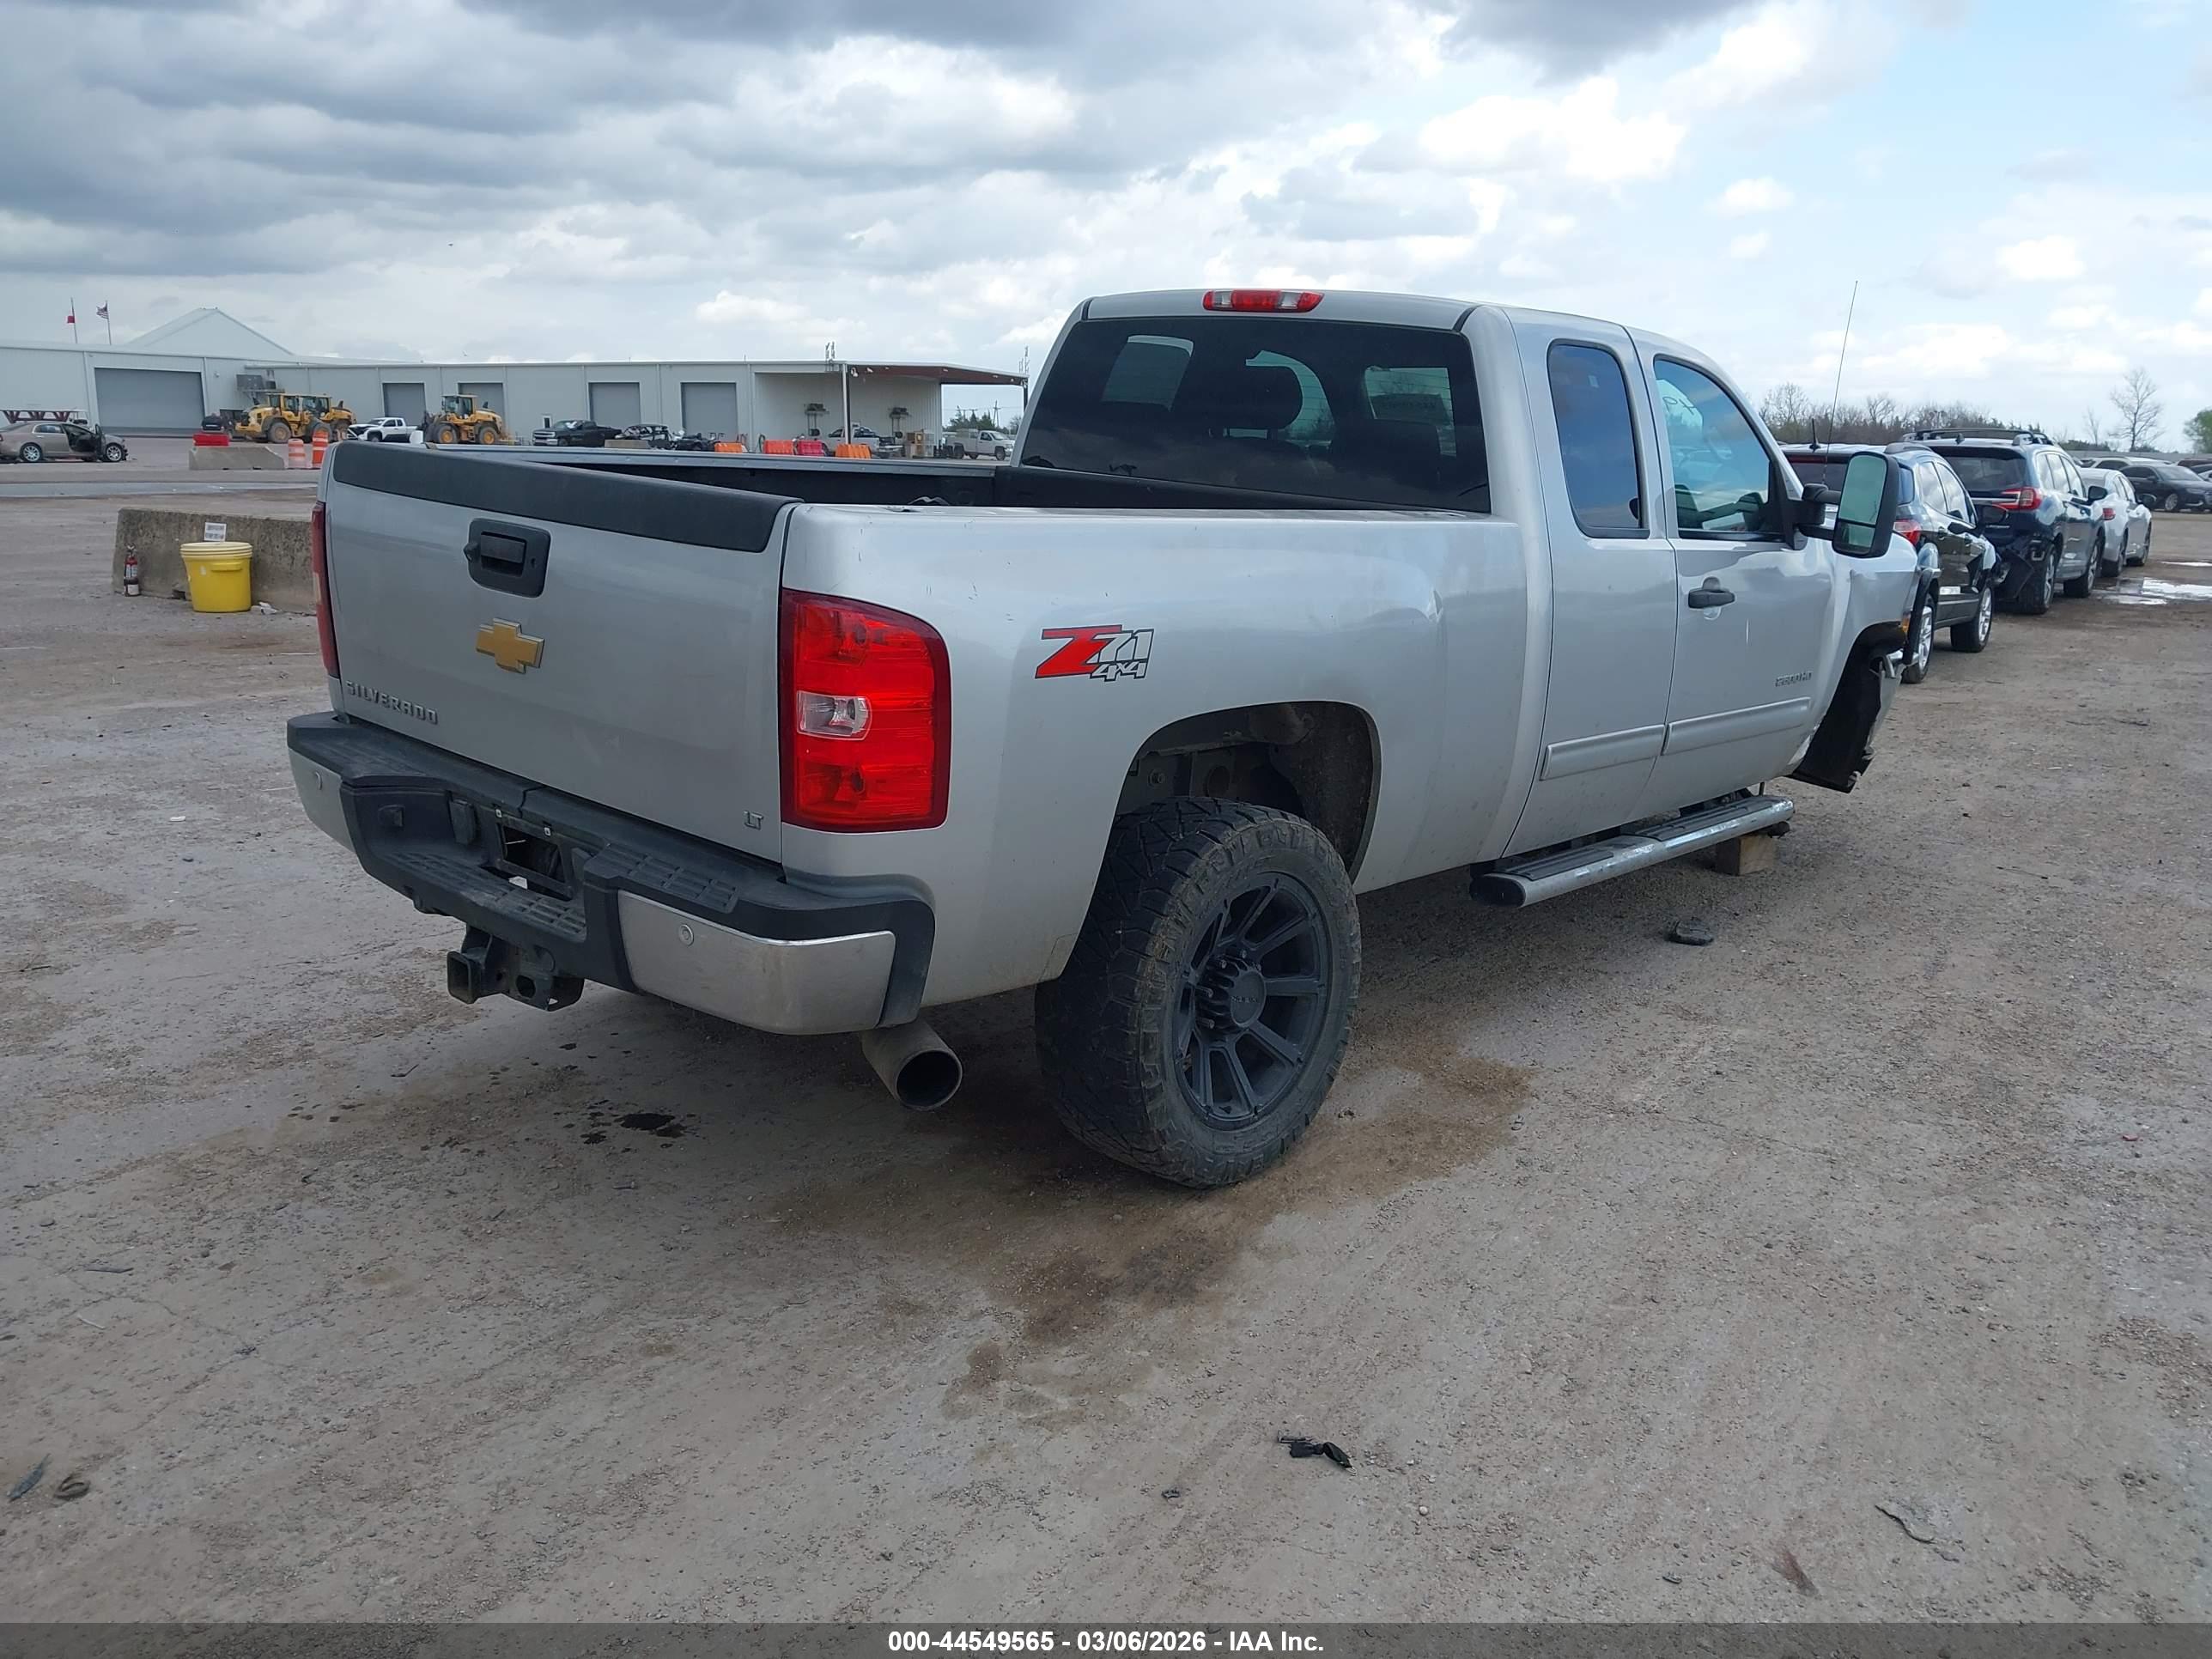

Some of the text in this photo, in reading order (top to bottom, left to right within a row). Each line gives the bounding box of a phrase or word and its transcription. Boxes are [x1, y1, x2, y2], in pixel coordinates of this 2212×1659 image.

[1035, 624, 1154, 679] Z71
[345, 679, 440, 726] SILVERADO
[744, 810, 764, 831] LT
